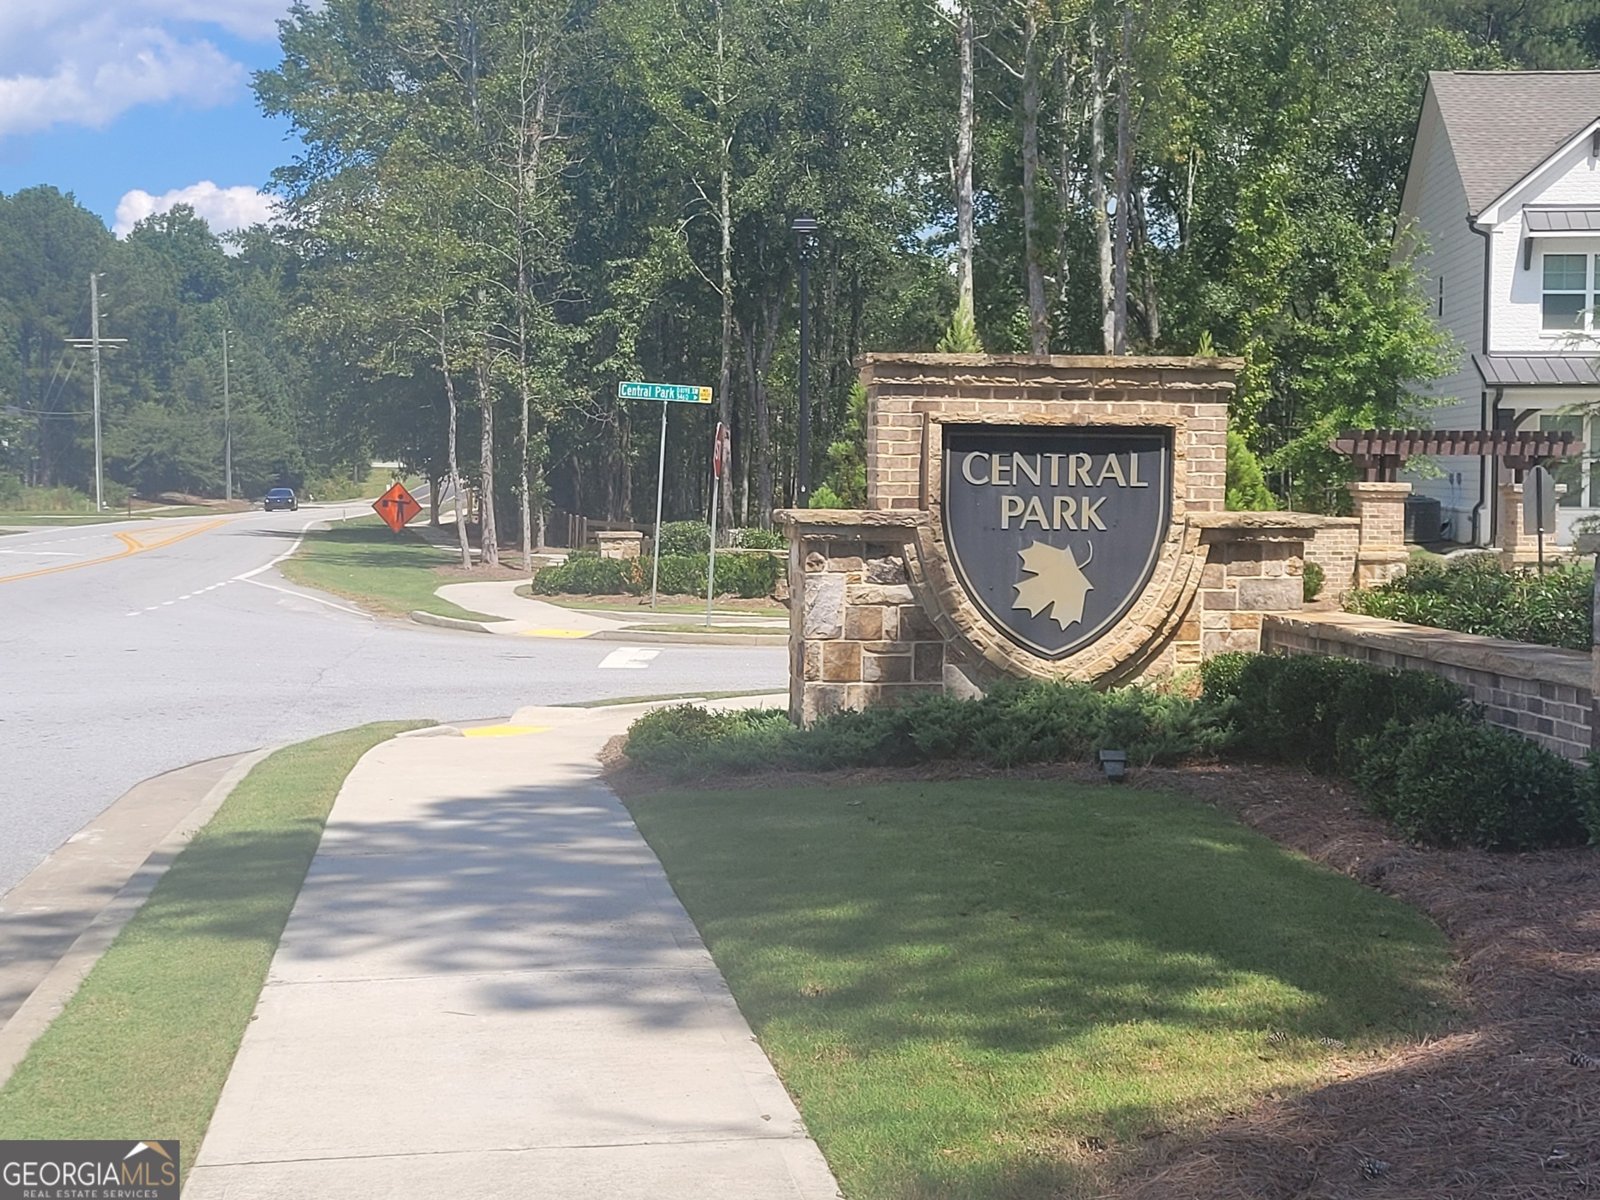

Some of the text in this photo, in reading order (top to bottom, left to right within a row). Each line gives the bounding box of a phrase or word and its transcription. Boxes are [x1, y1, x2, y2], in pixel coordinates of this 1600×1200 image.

[621, 384, 652, 397] Central
[655, 386, 675, 399] Park
[961, 451, 1149, 488] CENTRAL
[1000, 495, 1108, 531] PARK
